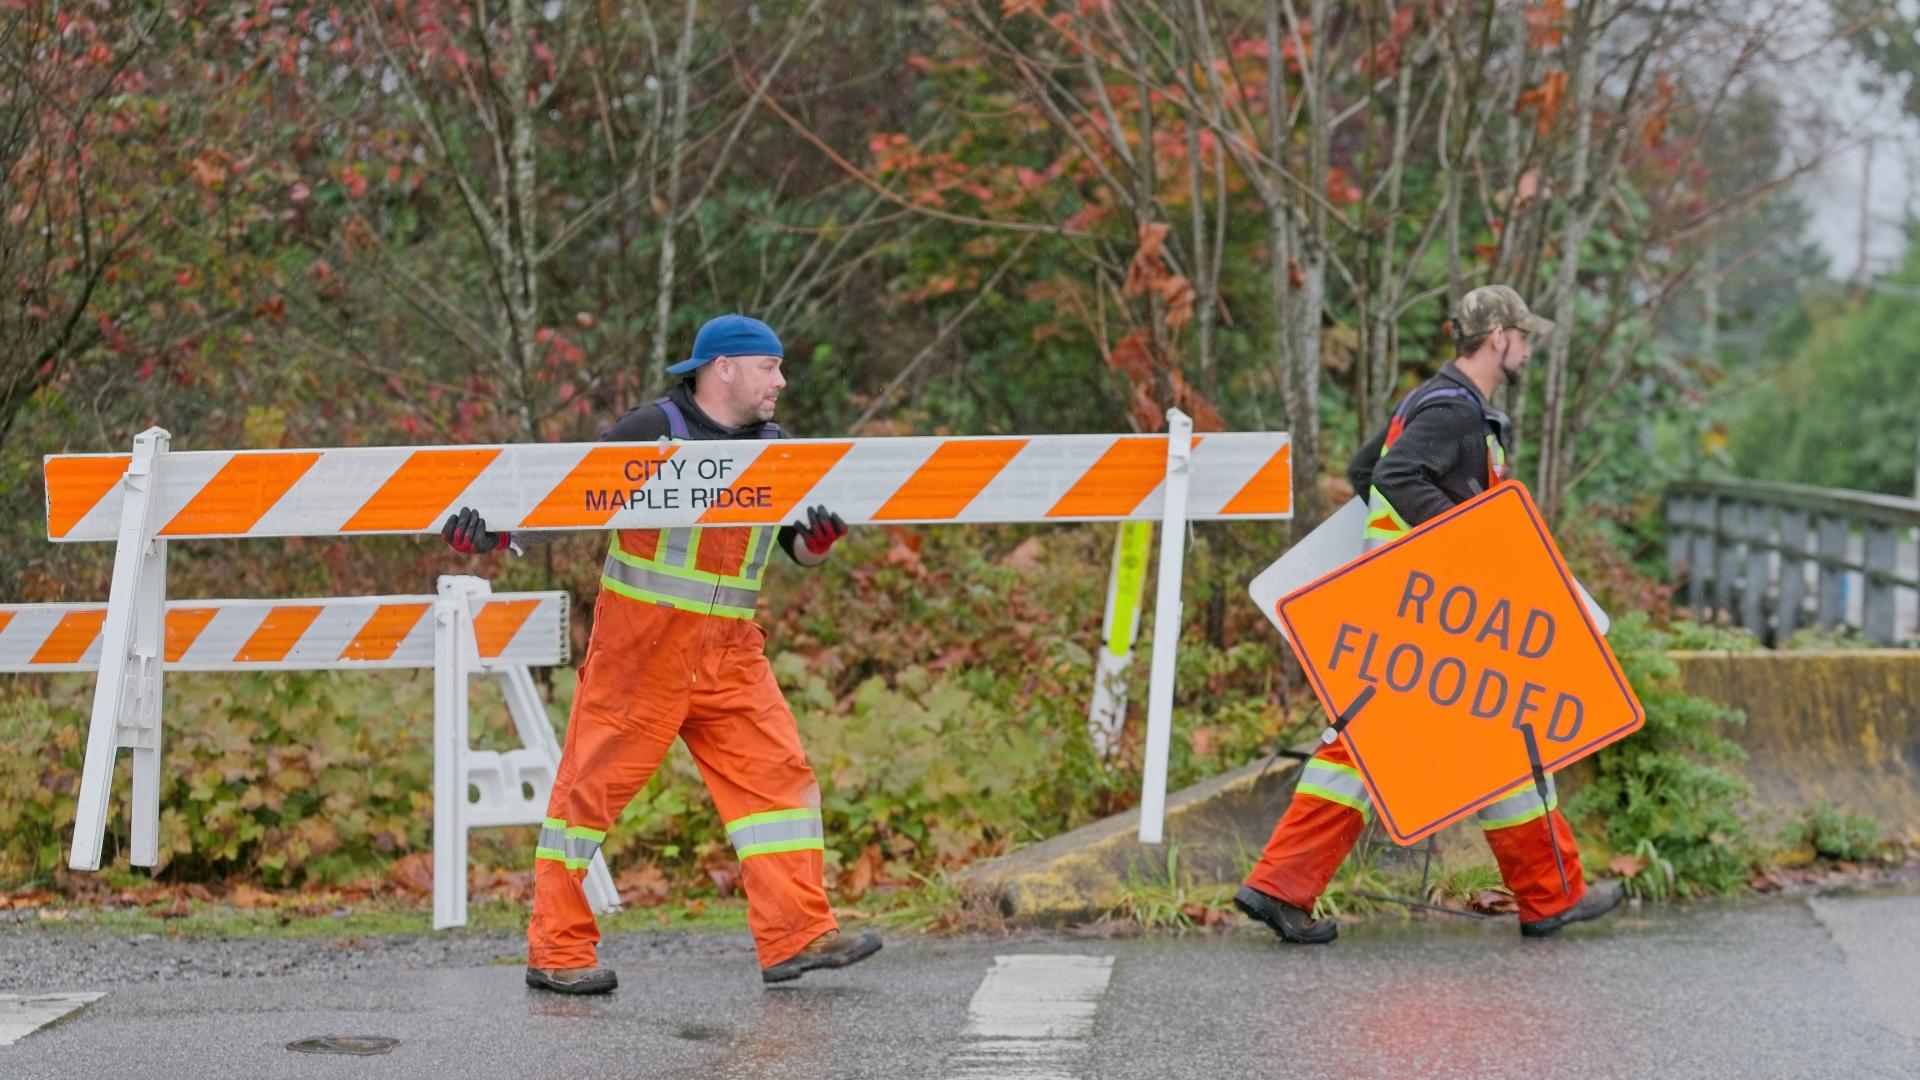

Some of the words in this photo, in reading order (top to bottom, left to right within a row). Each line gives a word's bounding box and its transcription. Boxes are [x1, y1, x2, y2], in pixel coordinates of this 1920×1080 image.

[624, 459, 687, 481] CITY
[698, 458, 734, 480] OF
[585, 488, 680, 511] MAPLE
[691, 486, 773, 509] RIDGE
[1397, 570, 1556, 659] ROAD
[1328, 623, 1585, 742] FLOODED
